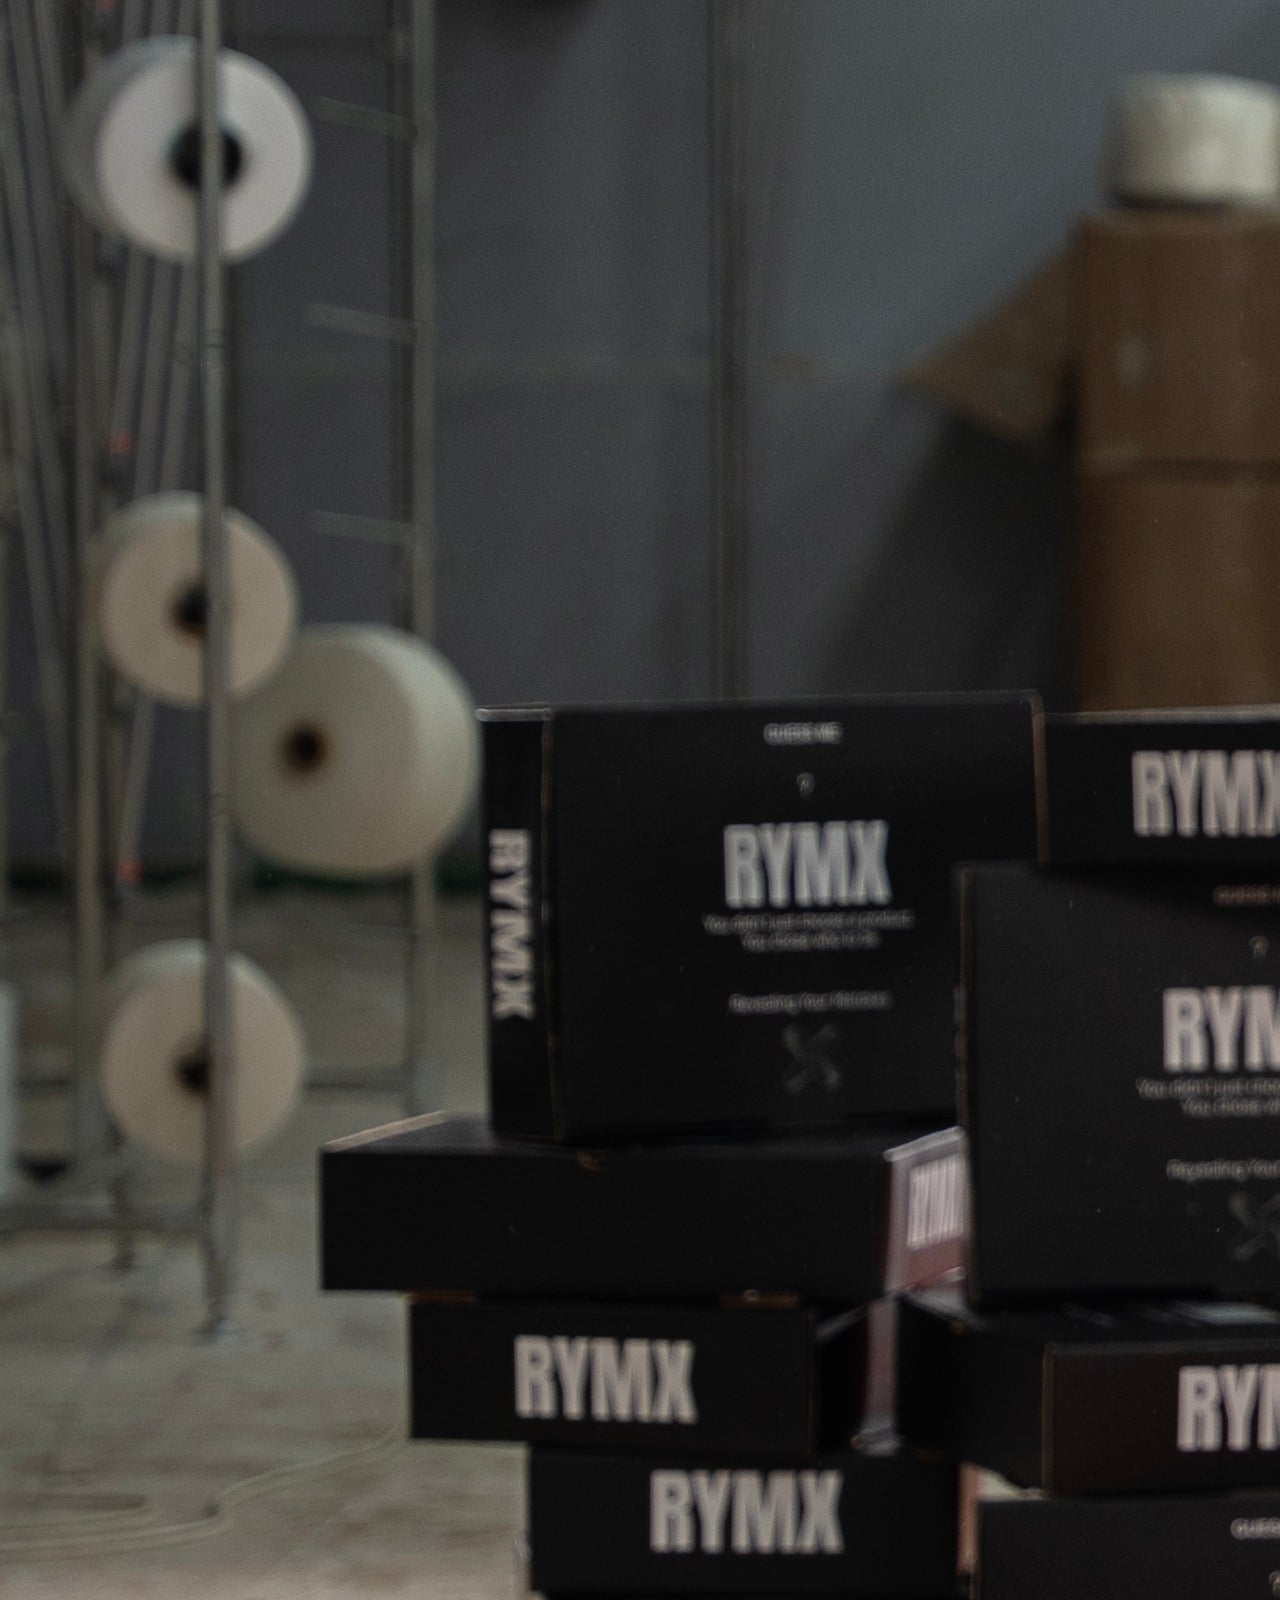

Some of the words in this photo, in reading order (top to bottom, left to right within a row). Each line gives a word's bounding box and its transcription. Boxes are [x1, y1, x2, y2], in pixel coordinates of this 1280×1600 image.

[725, 821, 891, 907] RYMX
[490, 830, 533, 1018] RYMX
[514, 1336, 696, 1423] RYMX
[651, 1470, 843, 1553] RYMX
